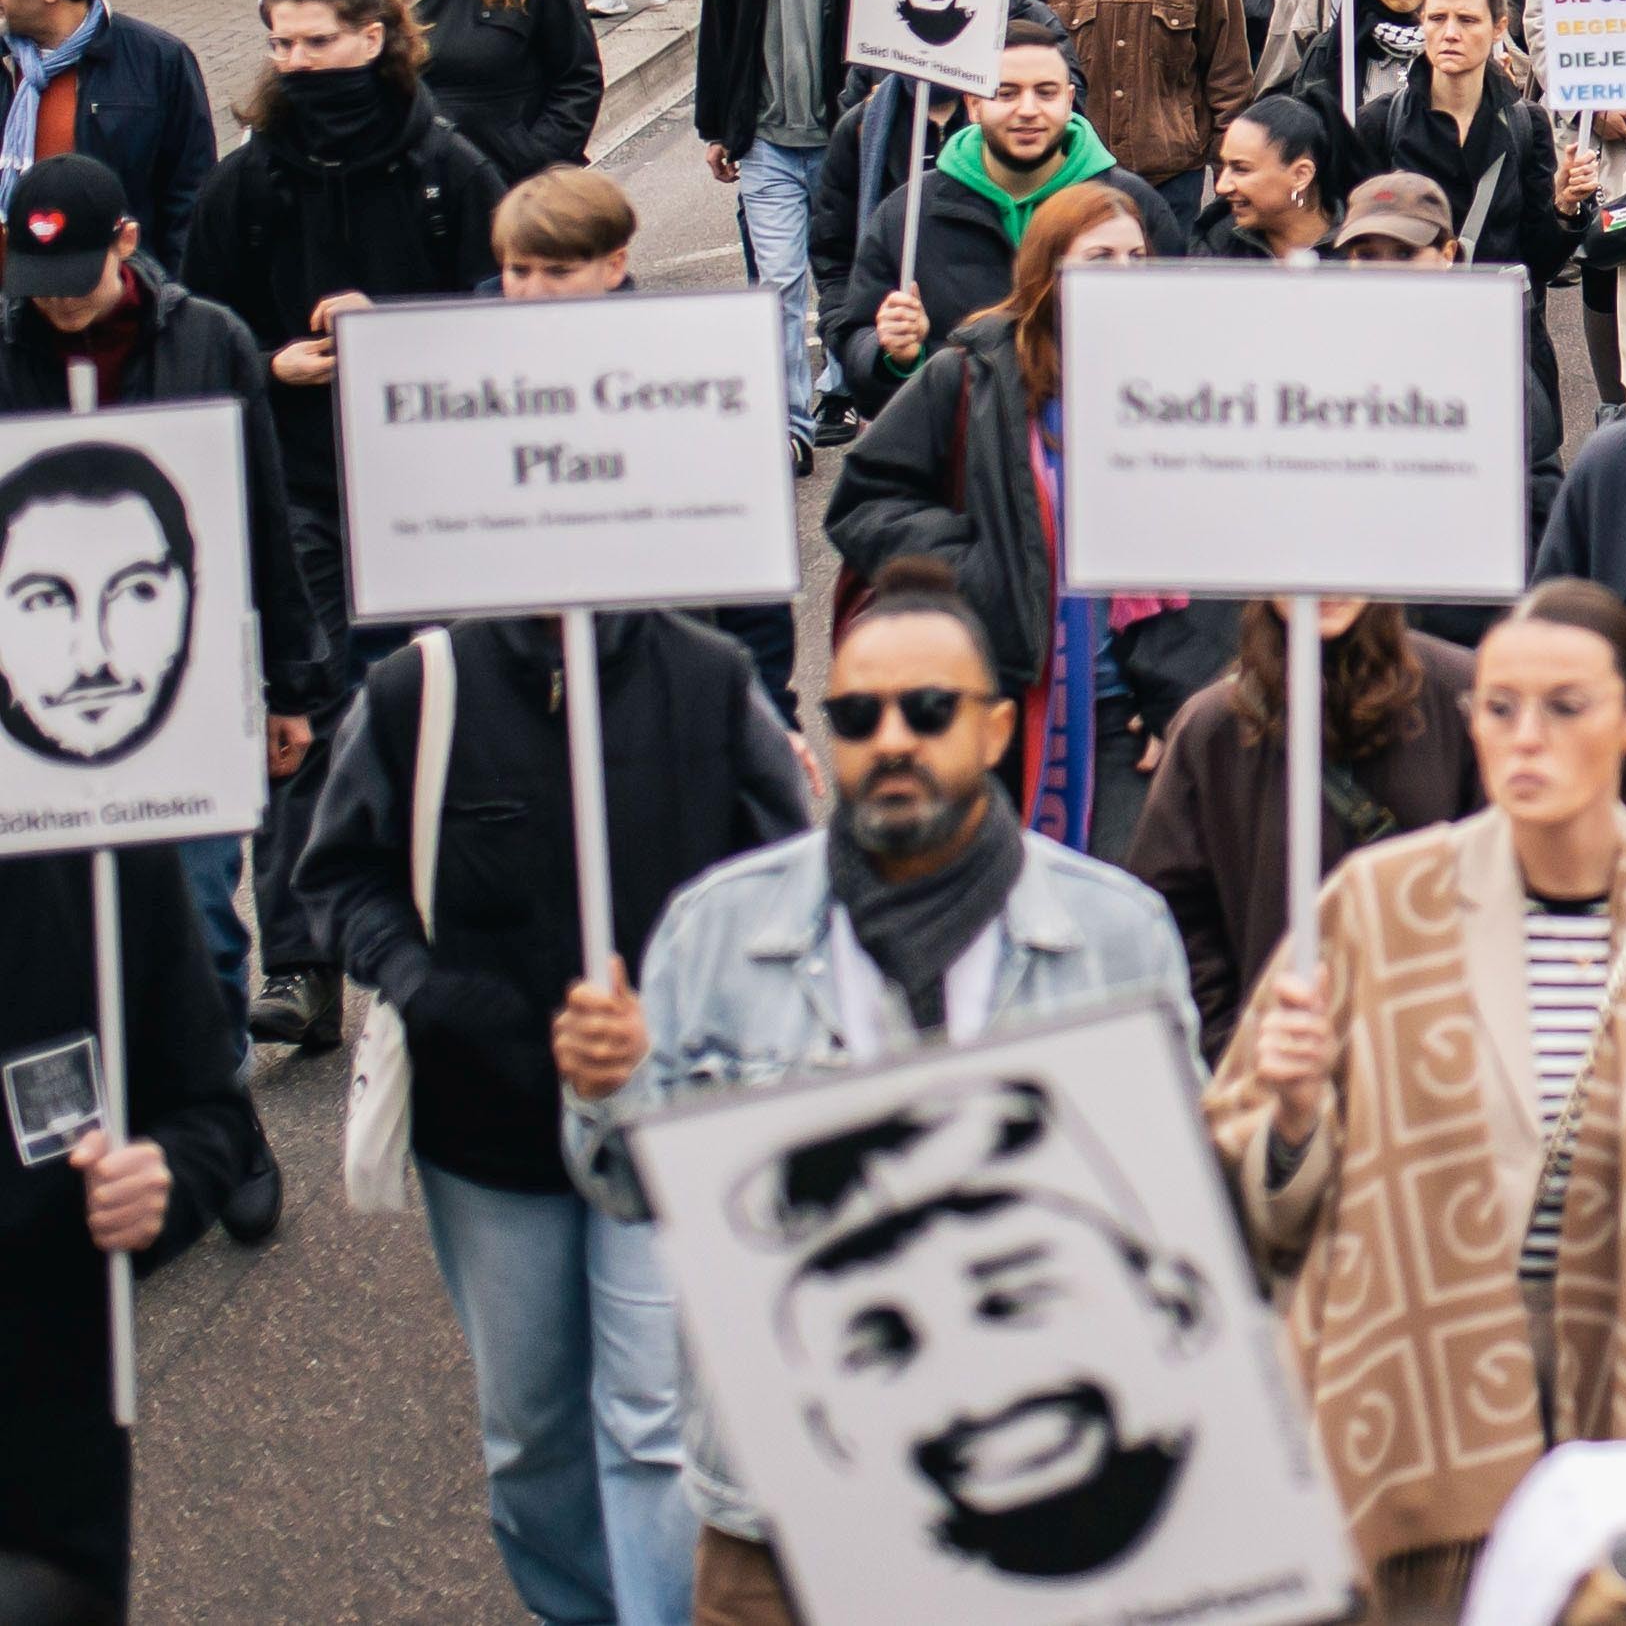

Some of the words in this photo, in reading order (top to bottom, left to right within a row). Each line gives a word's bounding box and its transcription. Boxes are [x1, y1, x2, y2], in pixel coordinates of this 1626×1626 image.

[383, 374, 577, 426] Eliakim
[593, 368, 750, 419] Georg
[1118, 377, 1259, 428] Sadri
[1275, 379, 1470, 430] Berisha
[511, 441, 627, 487] Pfau
